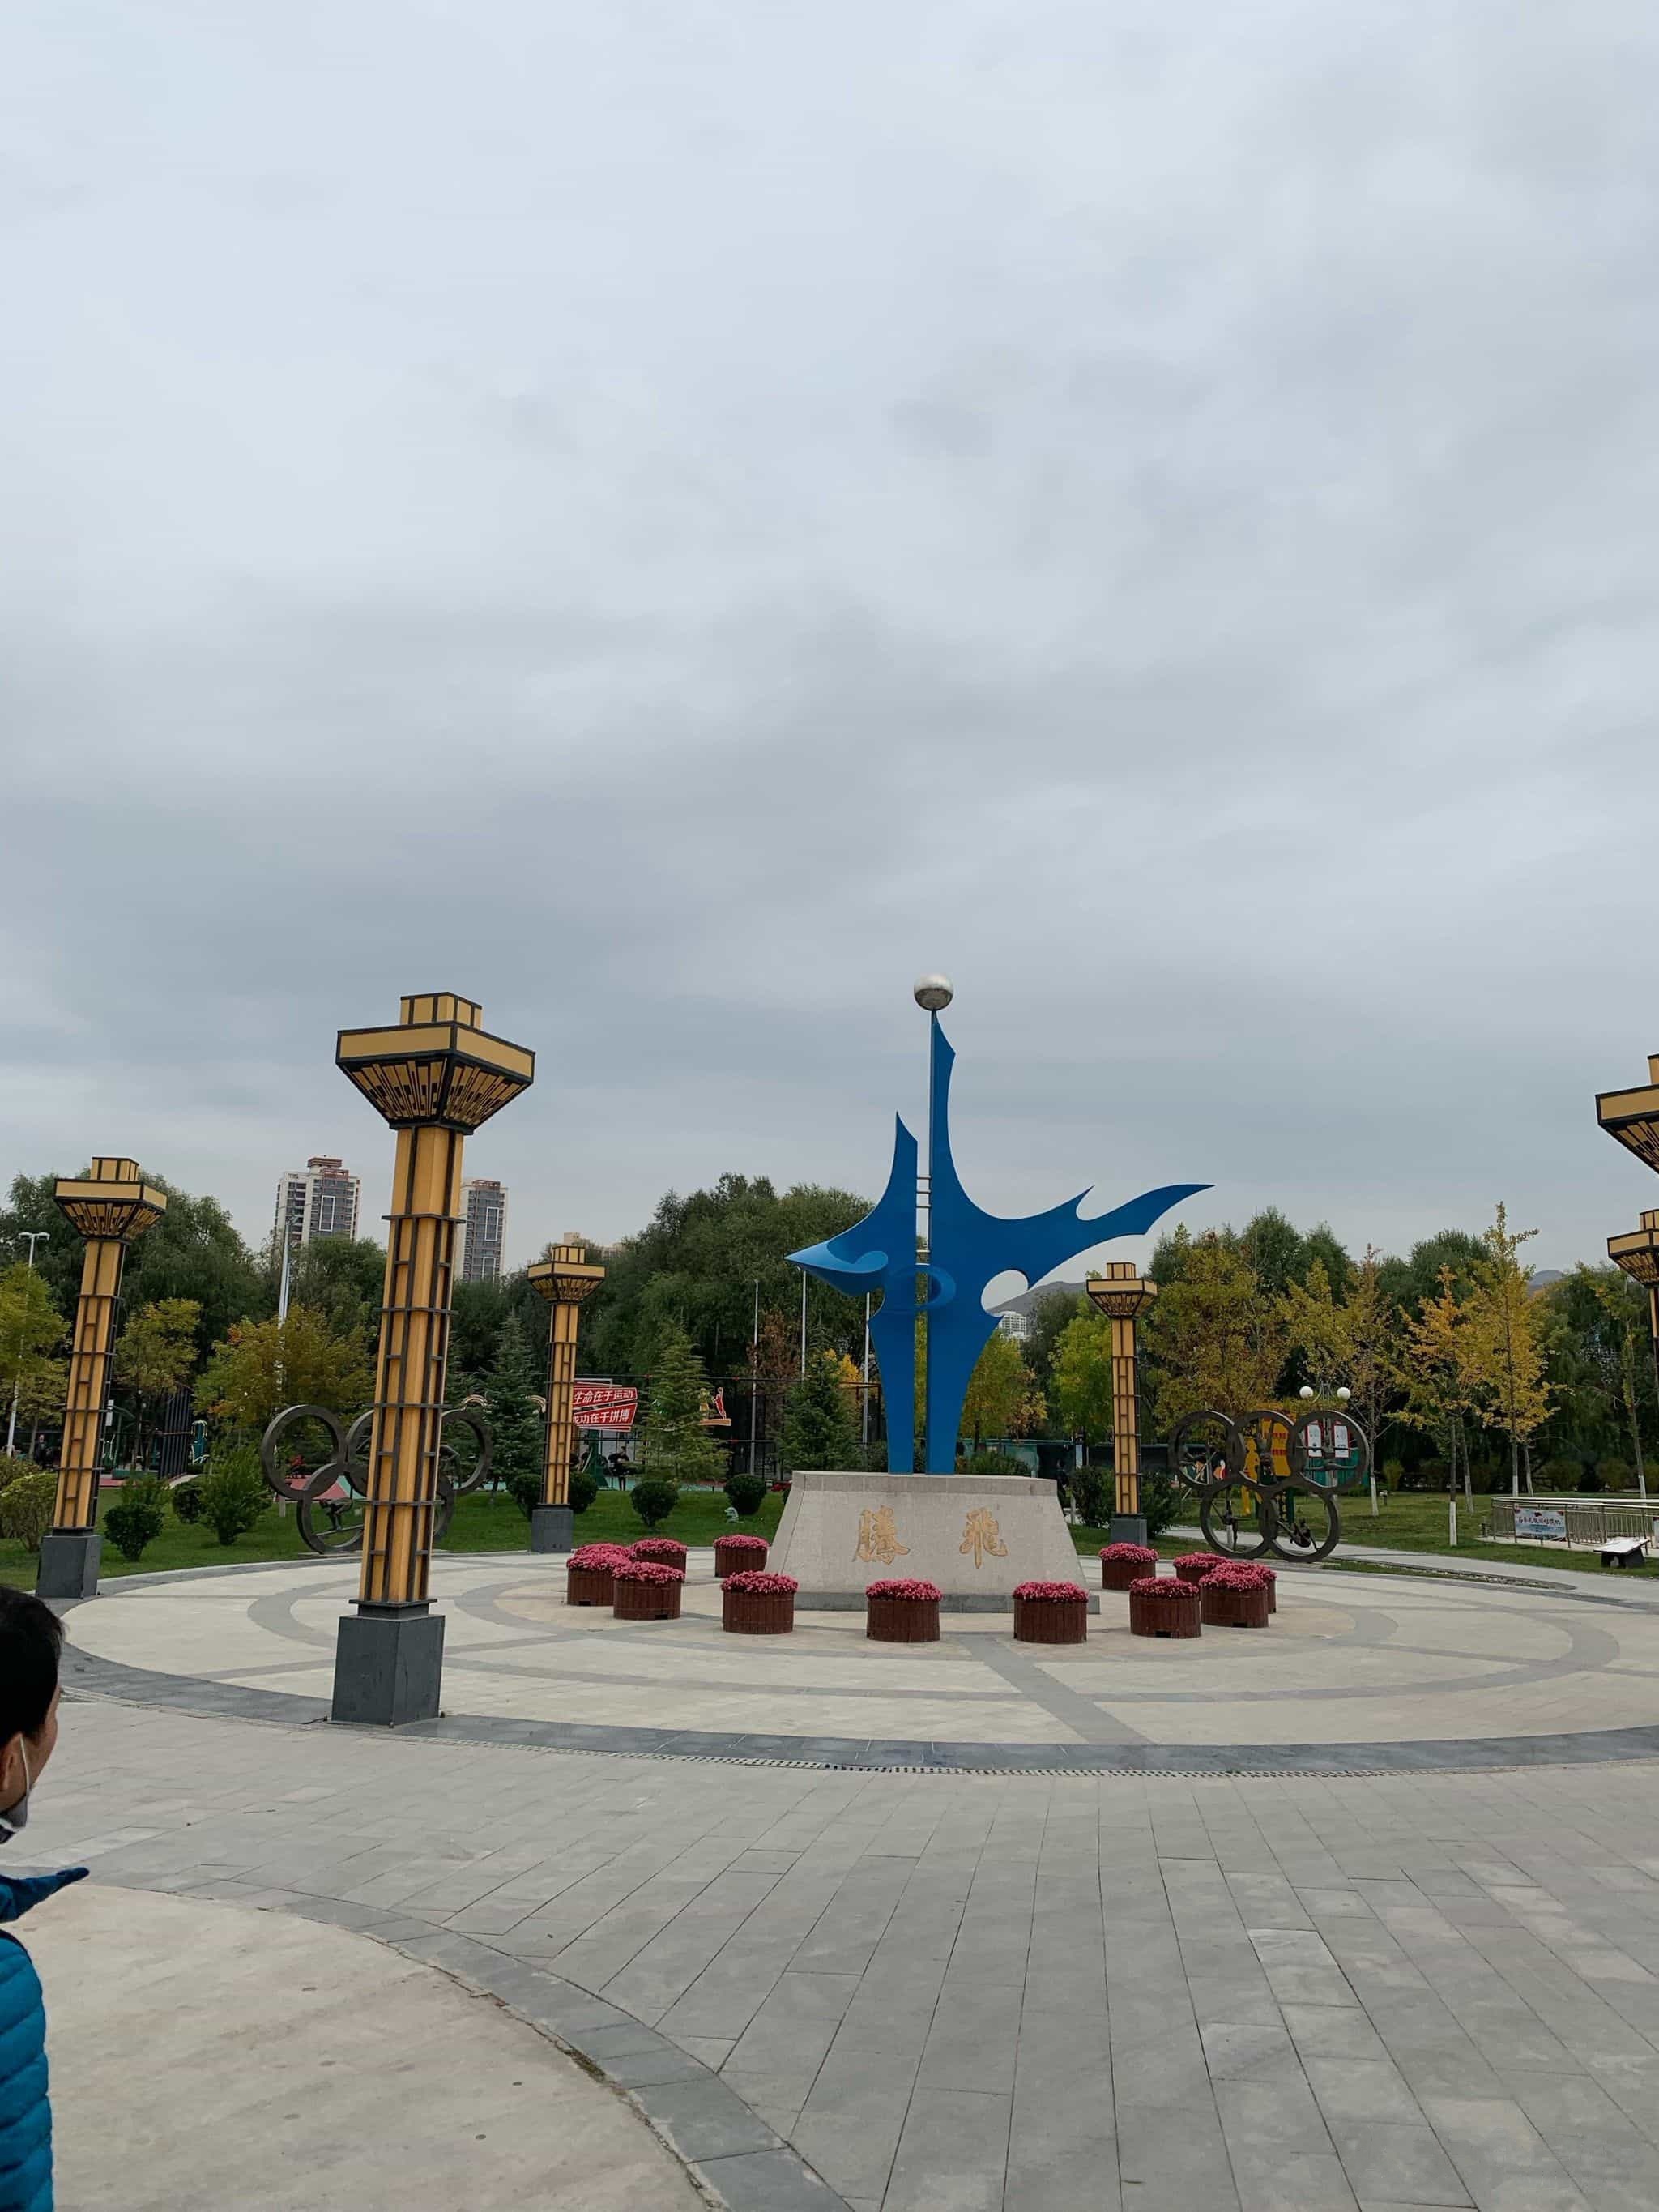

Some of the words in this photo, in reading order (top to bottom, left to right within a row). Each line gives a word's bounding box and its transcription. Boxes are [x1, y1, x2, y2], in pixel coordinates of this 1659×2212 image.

[573, 1390, 633, 1405] 生命在于运动
